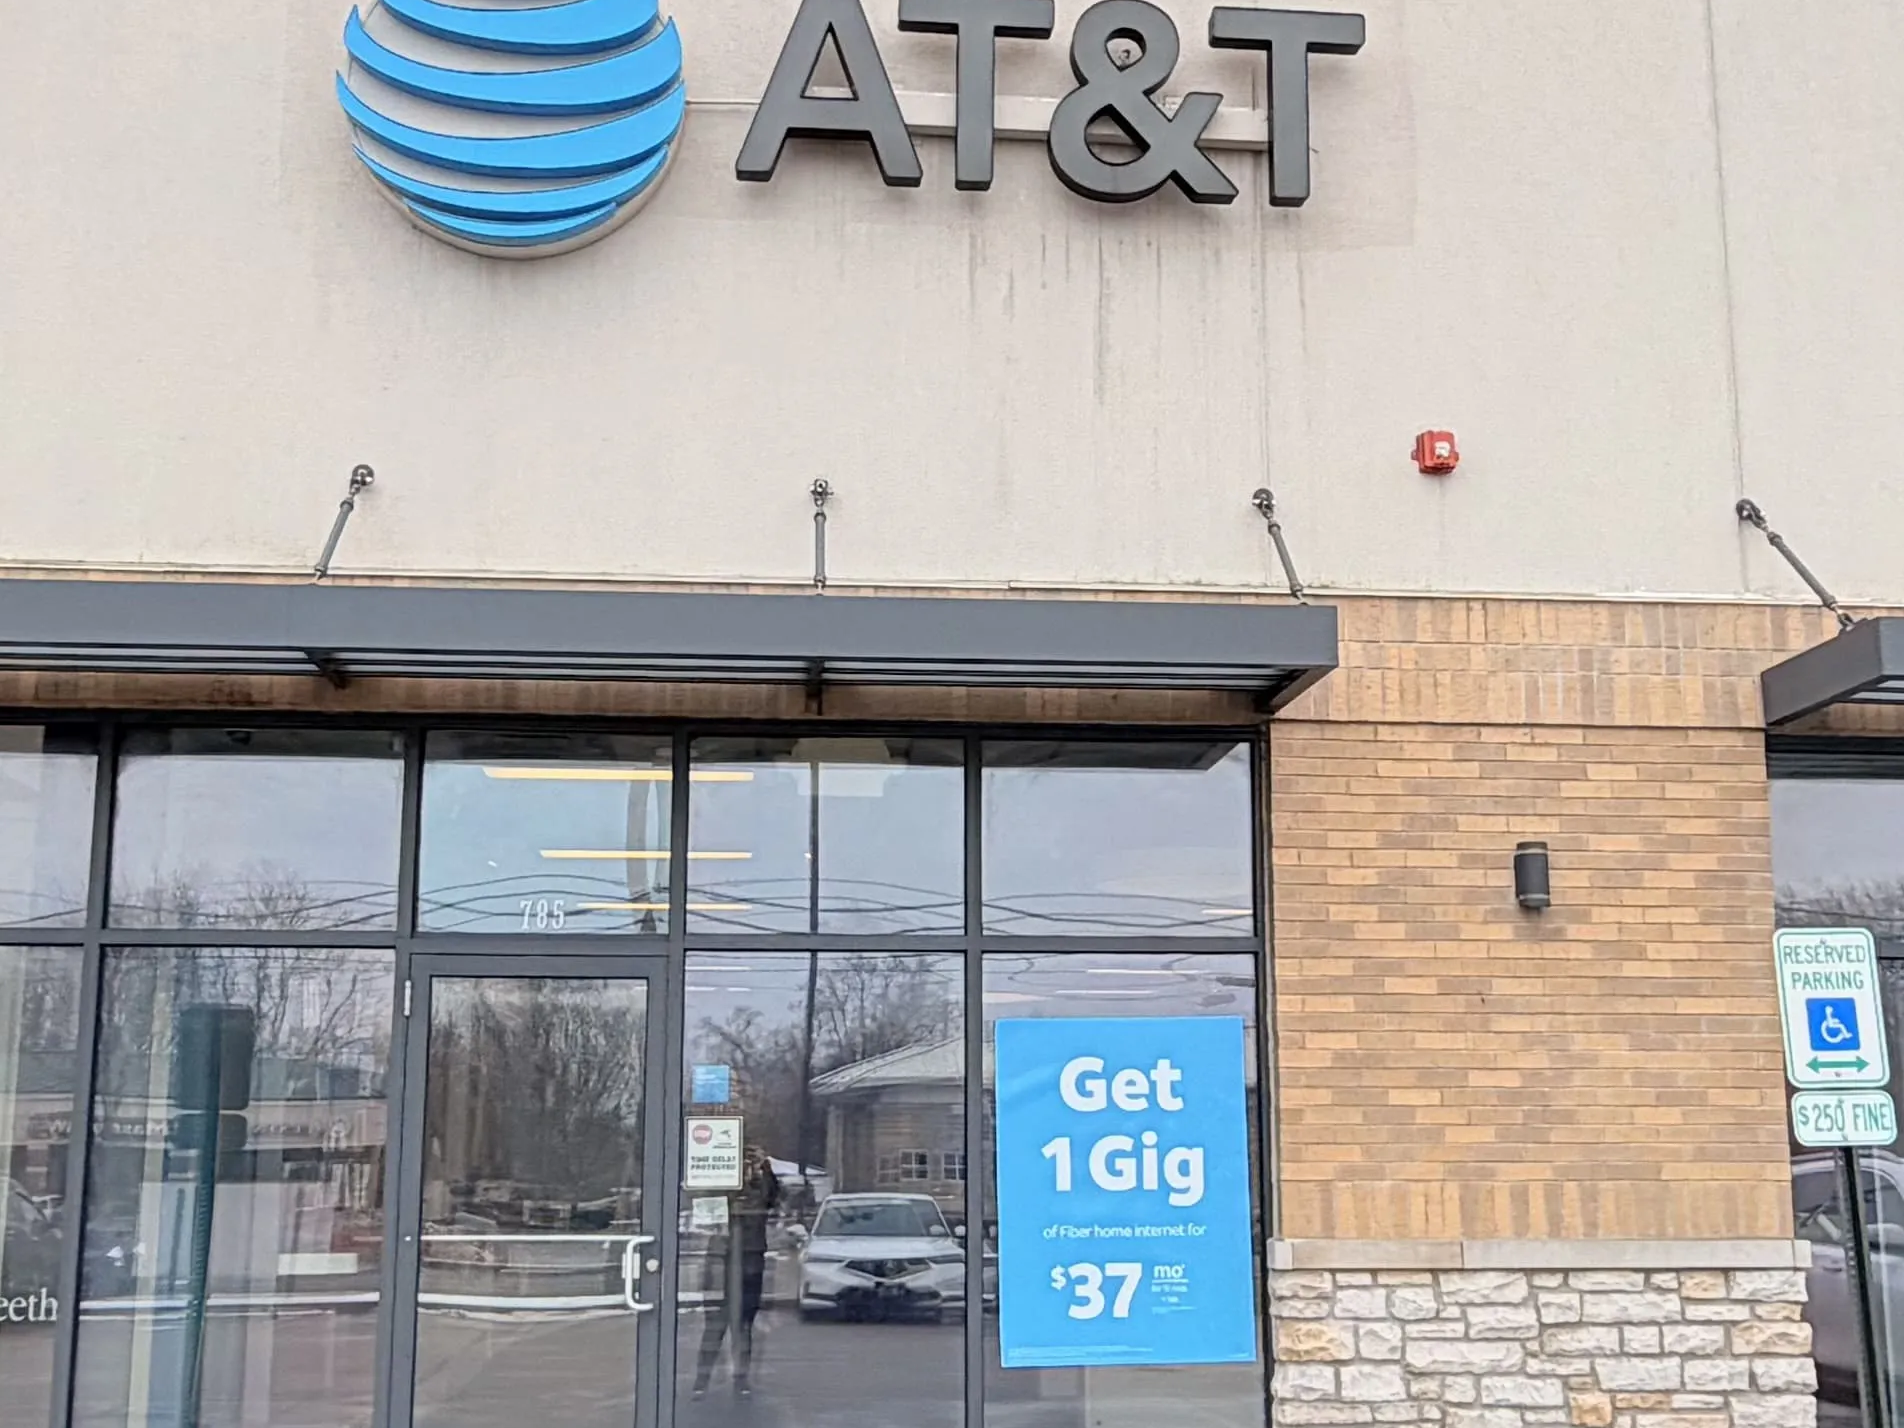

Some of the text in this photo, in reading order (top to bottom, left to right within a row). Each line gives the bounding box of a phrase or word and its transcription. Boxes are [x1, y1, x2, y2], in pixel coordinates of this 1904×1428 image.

[519, 898, 565, 930] 785
[1783, 944, 1866, 965] RESERVED
[1791, 971, 1865, 991] PARKING
[1059, 1056, 1184, 1112] Get
[1851, 1103, 1892, 1132] FINE
[1041, 1131, 1205, 1206] 1 Gig
[1043, 1224, 1058, 1239] of
[1094, 1224, 1132, 1238] home
[1134, 1224, 1186, 1237] internet
[1187, 1222, 1207, 1237] for
[1050, 1262, 1143, 1320] $37
